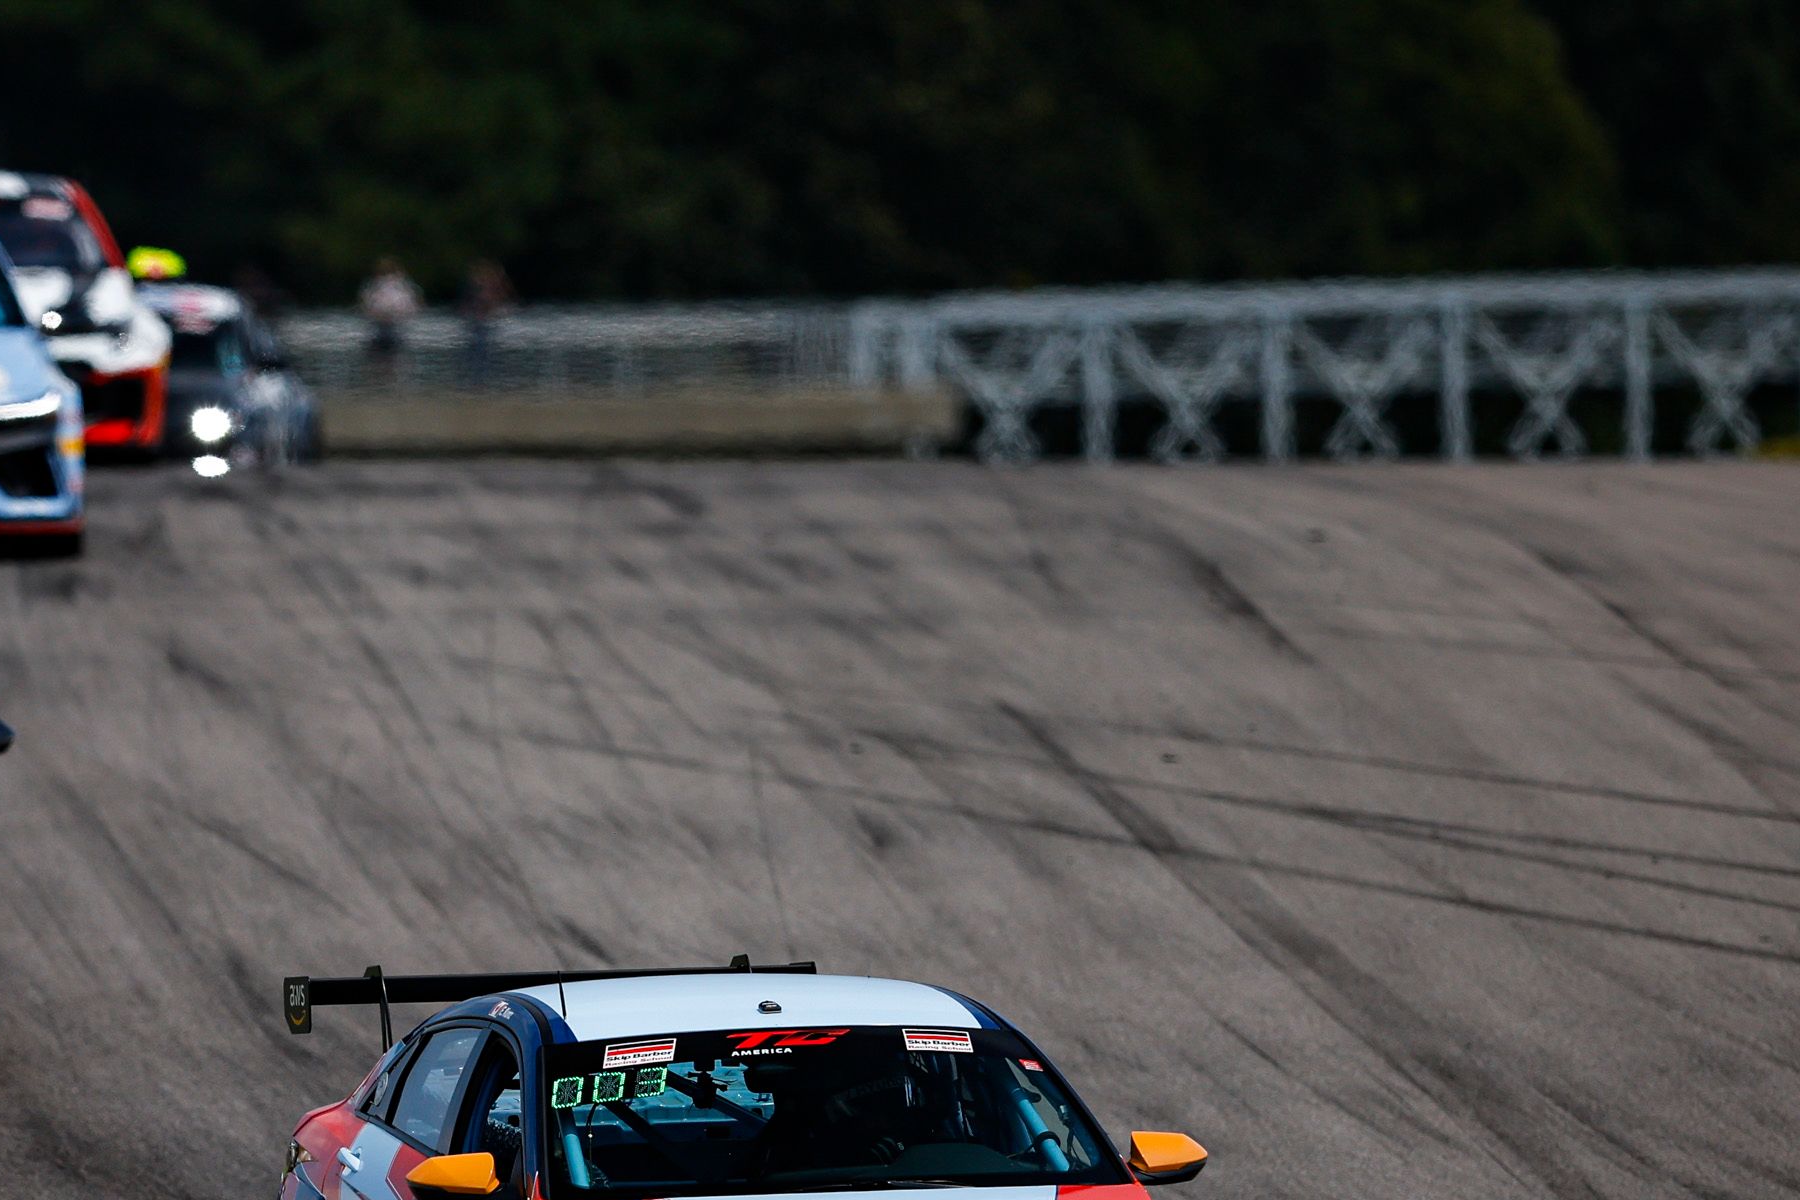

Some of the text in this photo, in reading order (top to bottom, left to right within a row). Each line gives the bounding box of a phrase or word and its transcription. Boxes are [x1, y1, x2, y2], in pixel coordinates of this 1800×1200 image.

[290, 985, 305, 1006] aws
[726, 1029, 850, 1049] TC
[932, 1039, 970, 1047] Barber
[606, 1050, 673, 1062] Skip Barber
[731, 1047, 792, 1057] AMERICA
[552, 1067, 667, 1109] 003
